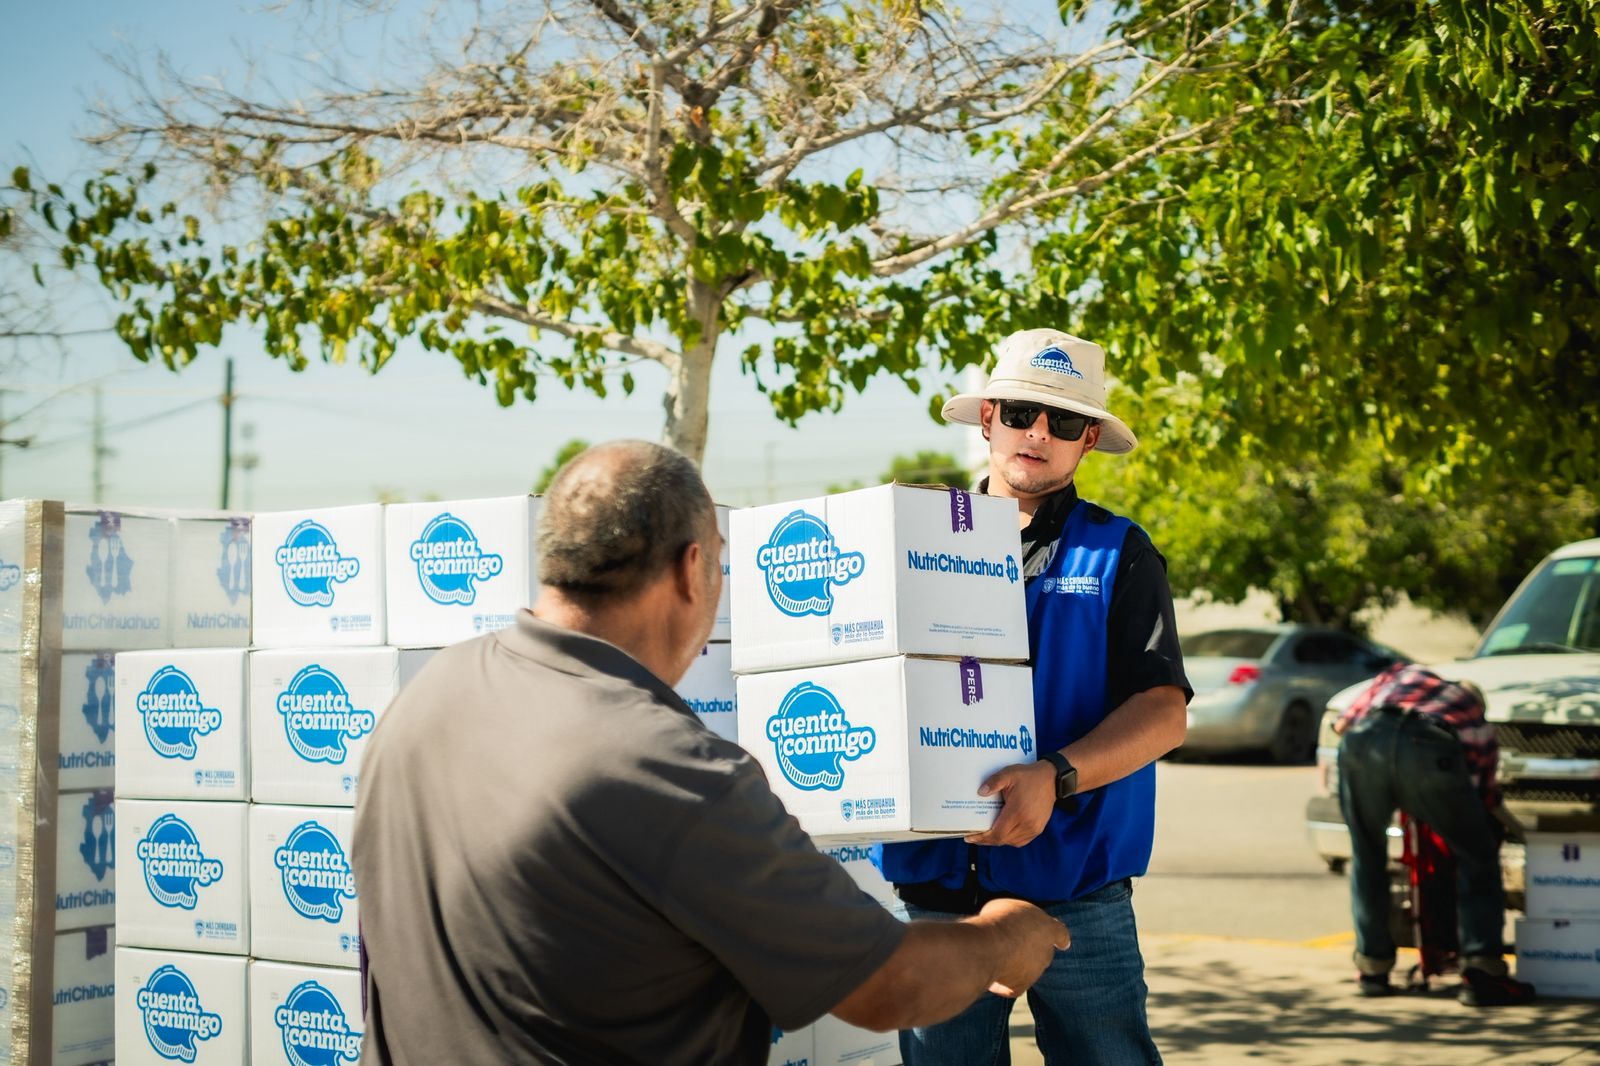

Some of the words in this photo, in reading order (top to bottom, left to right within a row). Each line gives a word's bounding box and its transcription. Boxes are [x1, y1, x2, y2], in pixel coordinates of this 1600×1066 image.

[1031, 358, 1071, 370] cuenta
[277, 541, 336, 562] cuenta
[411, 537, 476, 559] cuenta
[759, 537, 832, 566] cuenta
[287, 558, 358, 581] conmigo
[423, 556, 501, 579] conmigo
[773, 555, 862, 584] conmigo
[907, 550, 1004, 577] NutriChihuahua
[844, 621, 855, 633] MÁS
[856, 619, 884, 631] CHIHUAHUA
[967, 669, 977, 704] PERS
[139, 690, 197, 711] cuenta
[279, 690, 346, 712] cuenta
[149, 709, 221, 733] conmigo
[291, 711, 374, 737] conmigo
[769, 710, 843, 738] cuenta
[783, 729, 873, 757] conmigo
[919, 727, 1018, 750] NutriChihuahua
[856, 798, 866, 809] MÁS
[867, 797, 896, 808] CHIHUAHUA
[139, 839, 198, 860] cuenta
[276, 849, 343, 870] cuenta
[149, 858, 222, 885] conmigo
[288, 868, 356, 897] conmig
[139, 991, 198, 1013] cuenta
[149, 1010, 220, 1038] conmigo
[277, 1009, 344, 1032] cuenta
